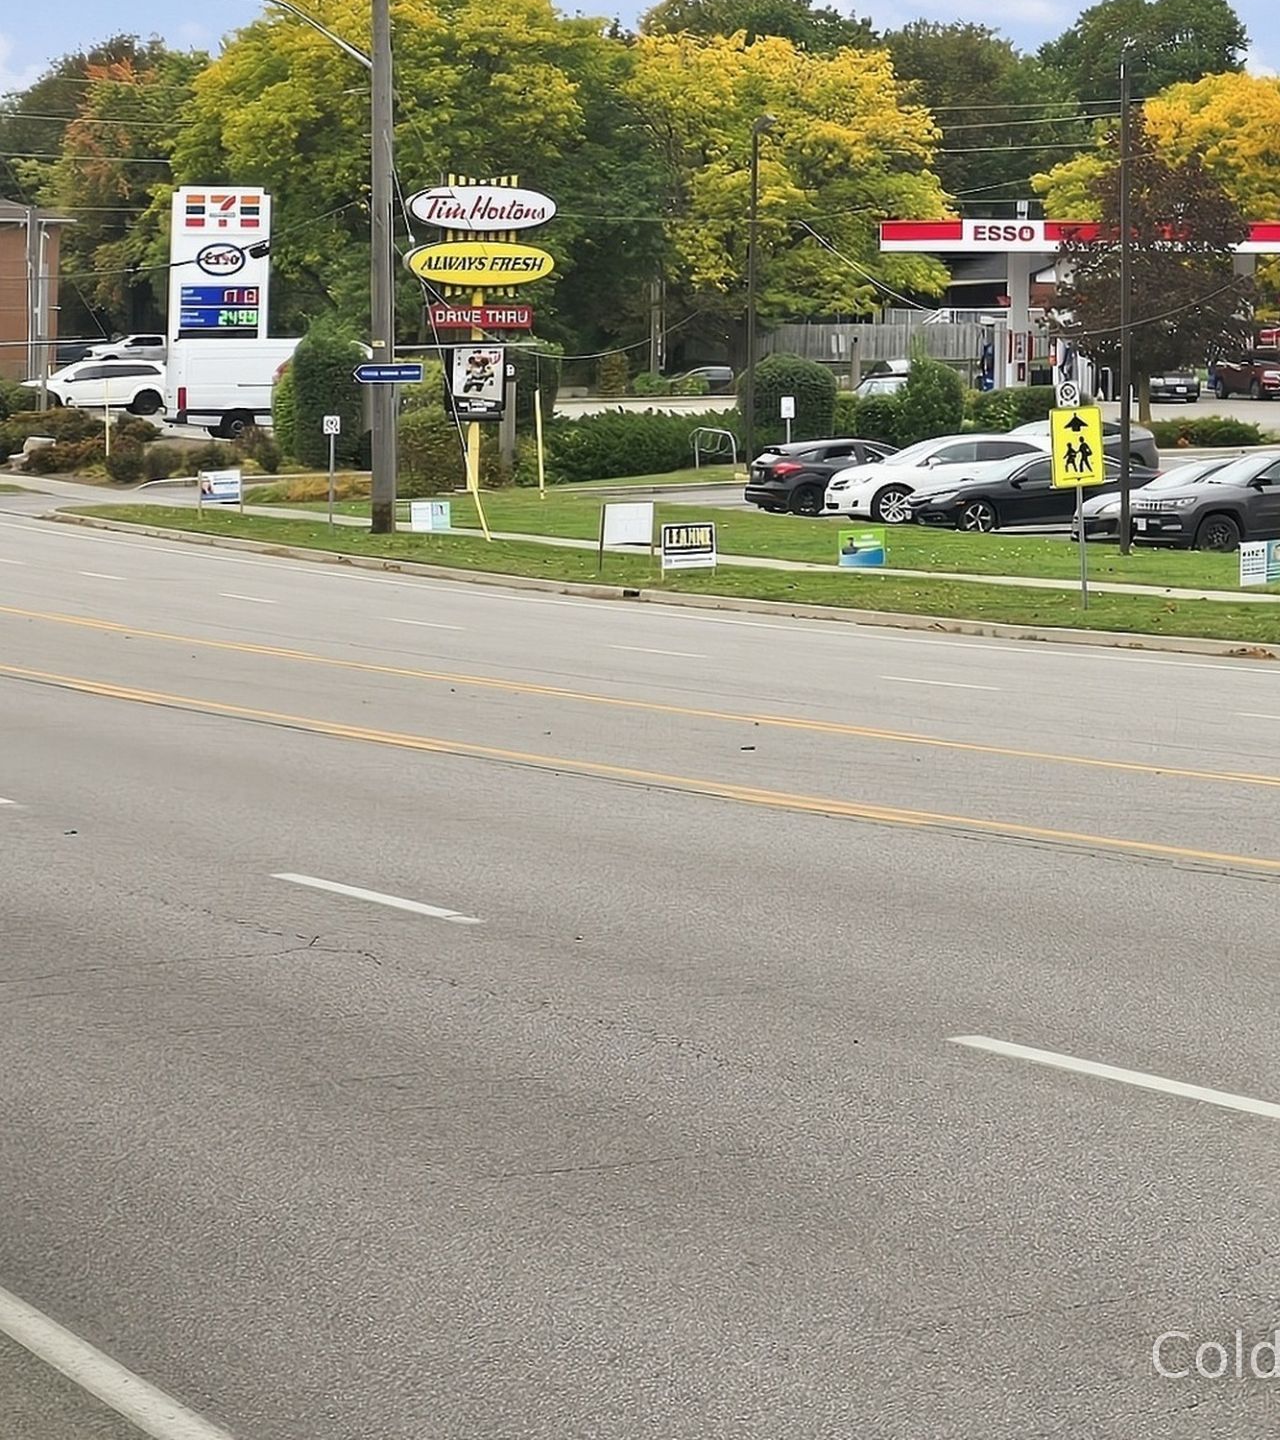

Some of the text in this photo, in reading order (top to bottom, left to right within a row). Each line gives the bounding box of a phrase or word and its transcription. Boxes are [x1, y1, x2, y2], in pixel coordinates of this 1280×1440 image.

[426, 195, 546, 220] Tim Hortons
[973, 225, 1035, 241] ESSO
[421, 256, 545, 272] ALWAYS FRESH
[435, 310, 529, 323] DRIVE THRU
